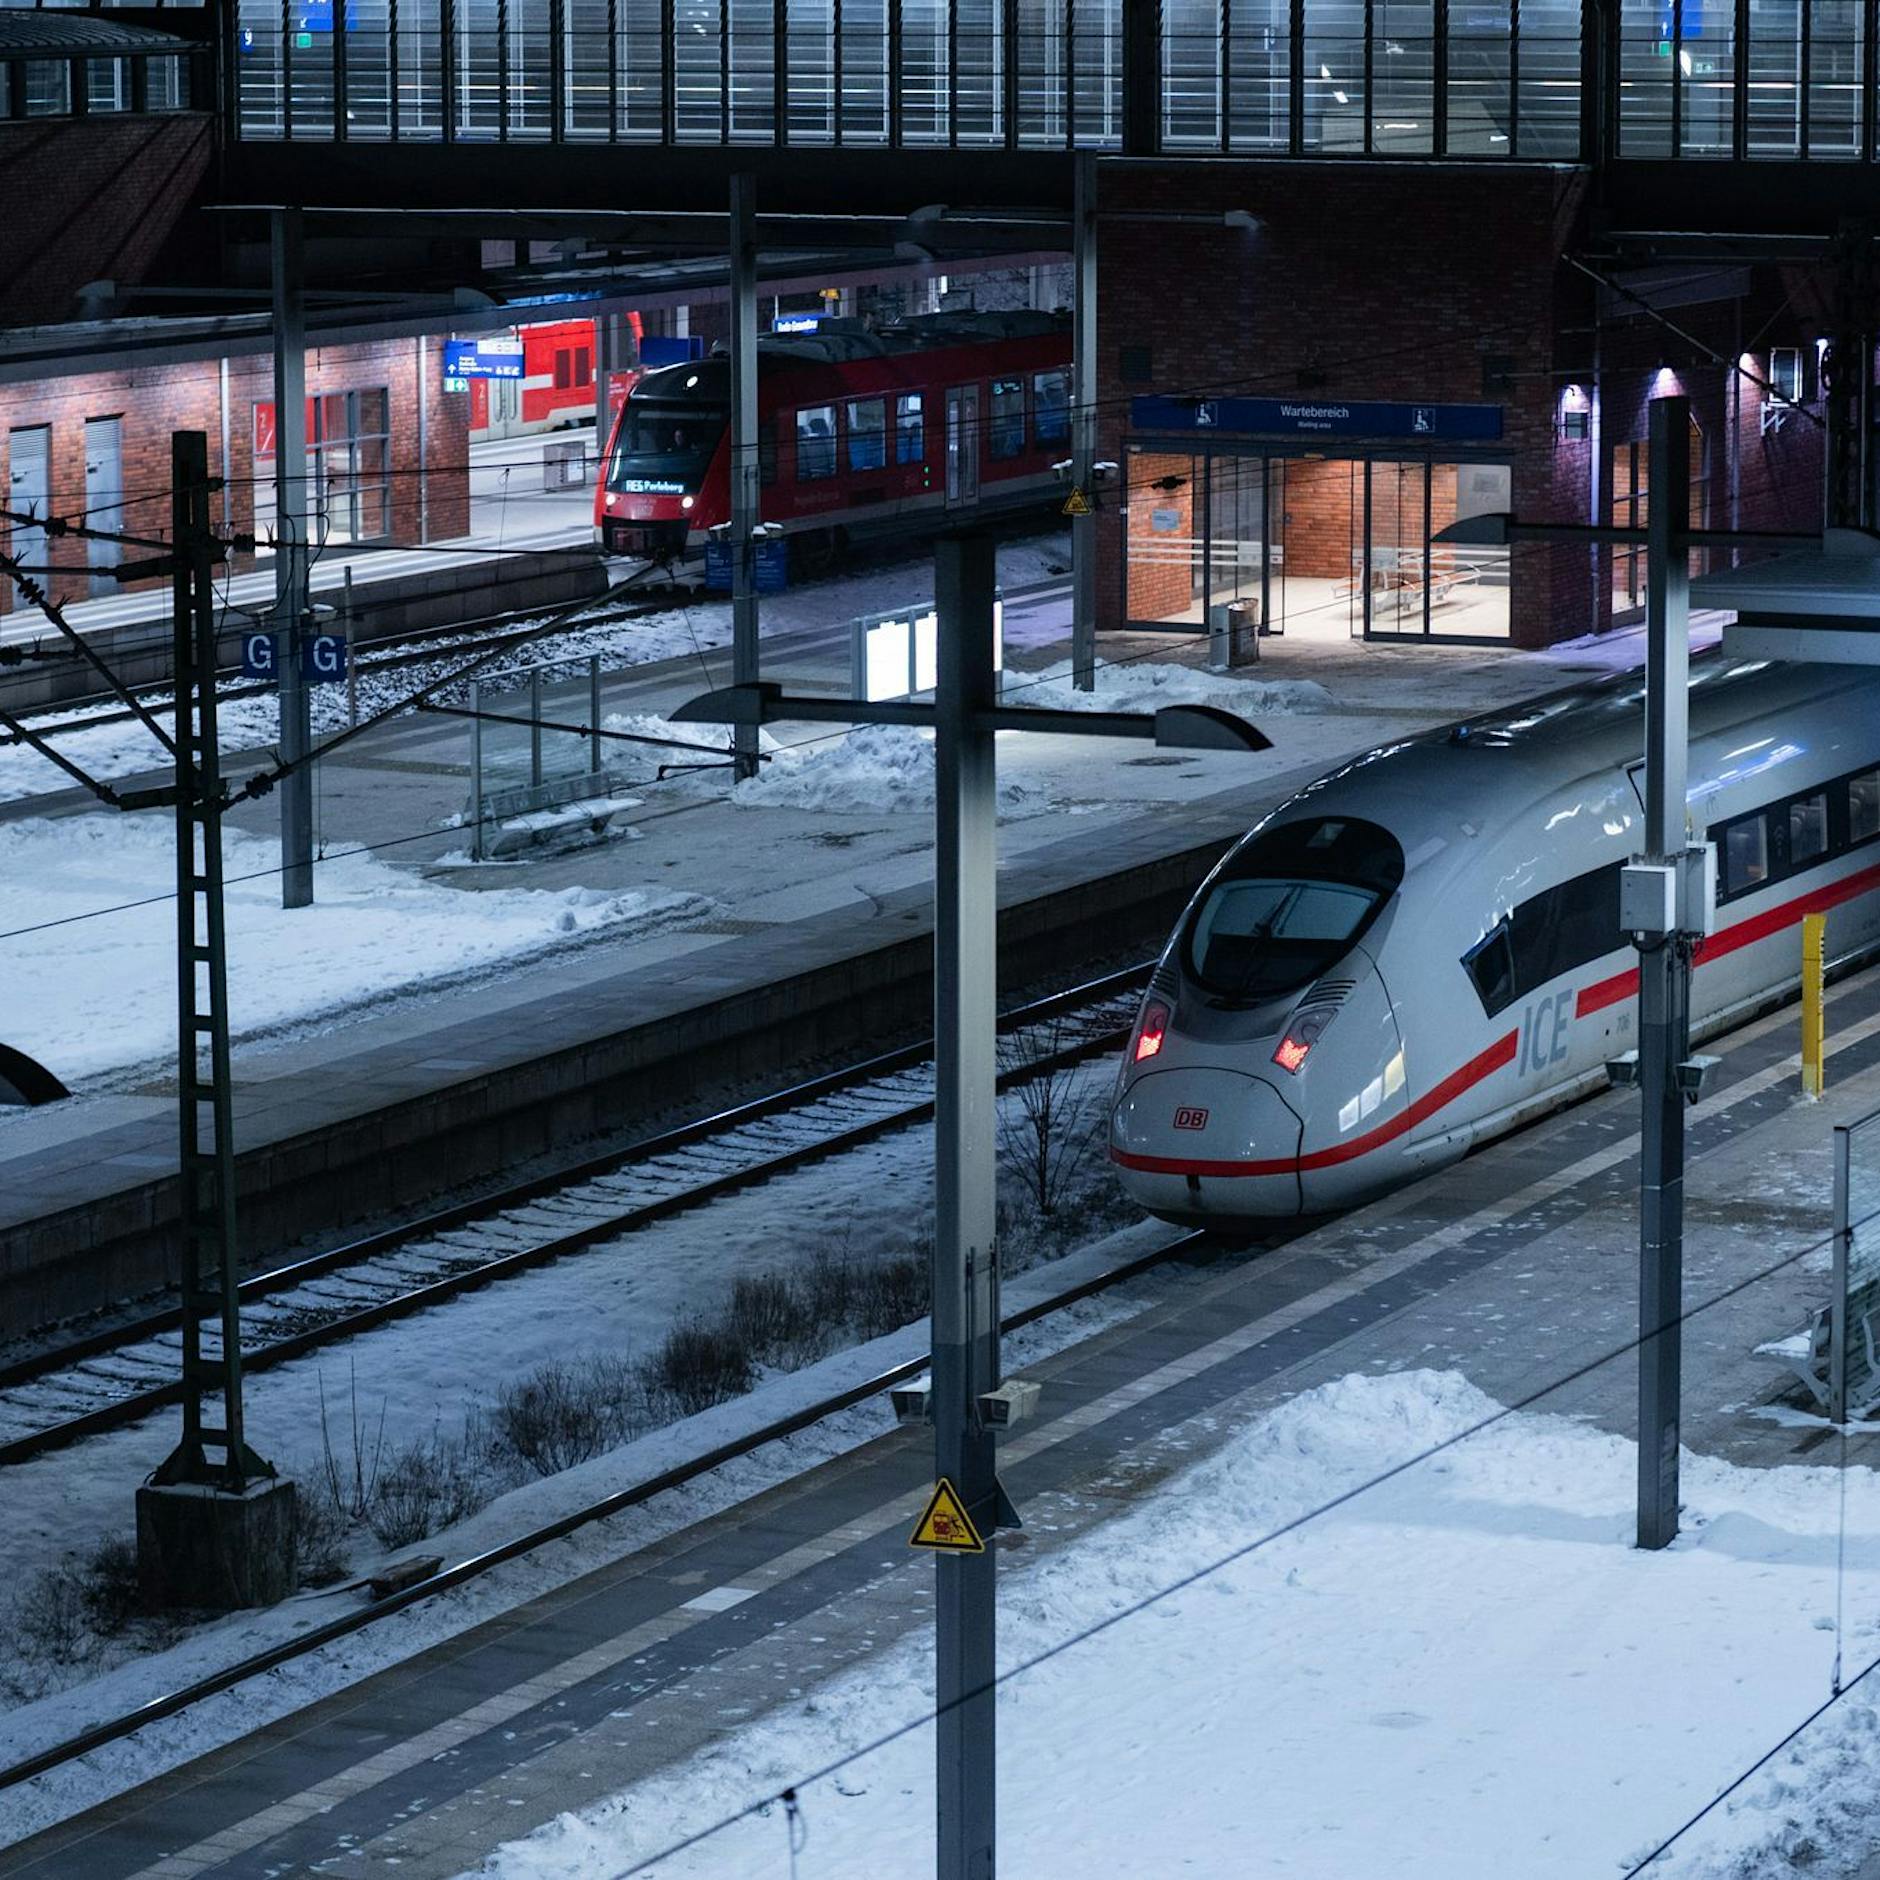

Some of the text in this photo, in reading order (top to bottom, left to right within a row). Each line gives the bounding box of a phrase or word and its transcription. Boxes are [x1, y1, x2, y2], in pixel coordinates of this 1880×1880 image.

[1280, 404, 1350, 418] Wartebereich
[247, 635, 272, 670] G
[313, 636, 338, 672] G
[1519, 988, 1574, 1078] ICE
[1177, 1110, 1205, 1127] DB
